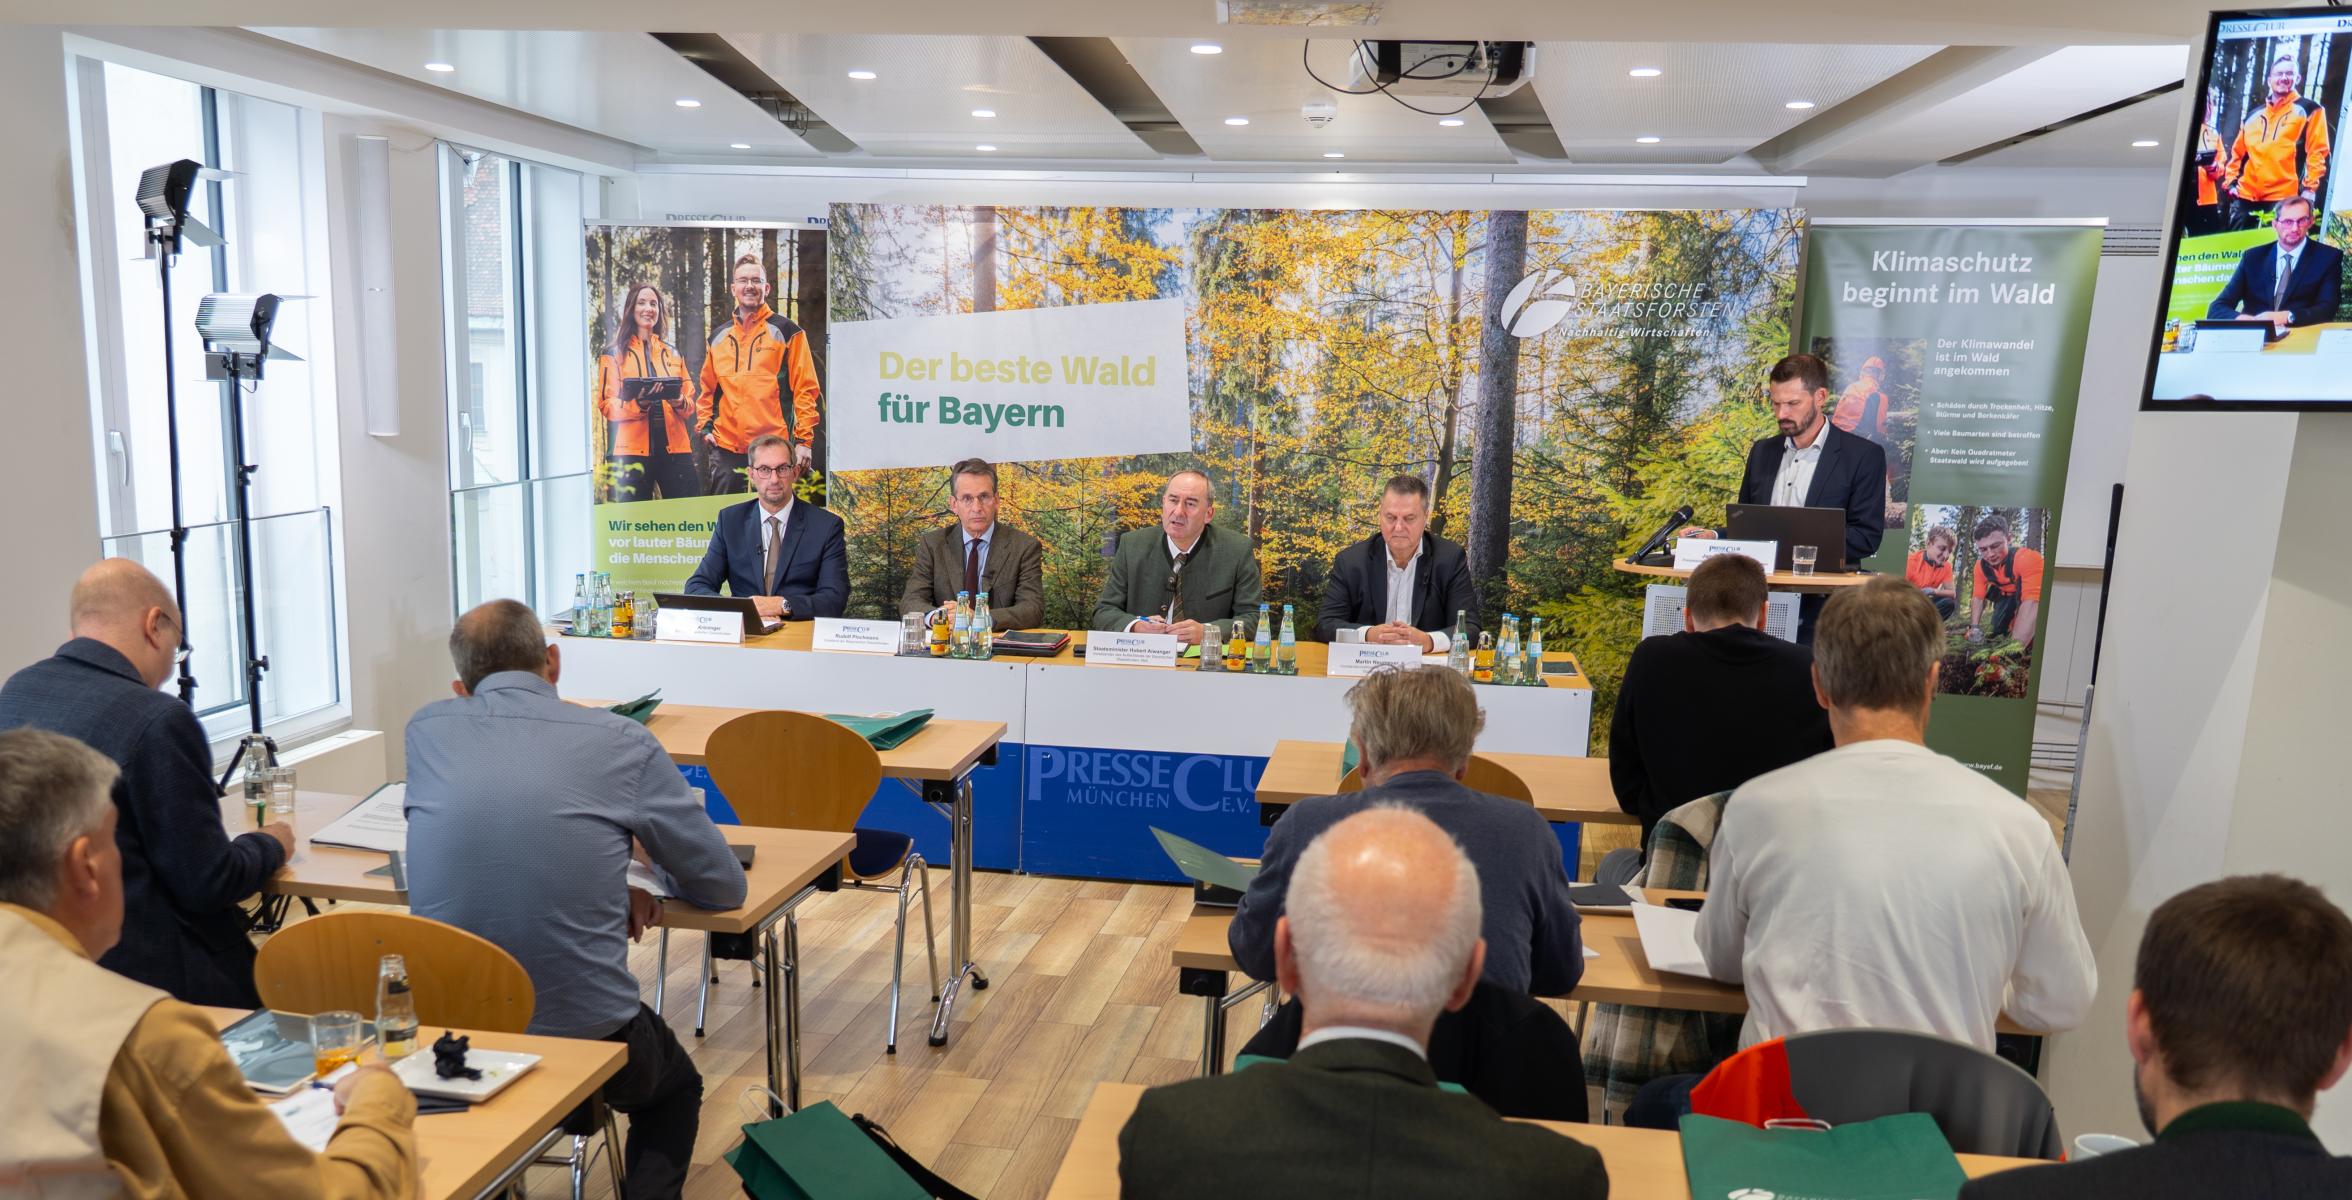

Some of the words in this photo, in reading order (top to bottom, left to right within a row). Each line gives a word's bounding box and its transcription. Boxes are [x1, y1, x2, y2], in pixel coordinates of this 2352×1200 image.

[1872, 250, 2033, 273] Klimaschutz
[1580, 283, 1707, 299] BAYERISCHE
[1842, 282, 1939, 308] beginnt
[1948, 283, 1979, 304] im
[1990, 283, 2055, 305] Wald
[1574, 302, 1737, 318] STAATSFORSTEN
[1559, 328, 1625, 339] Nachhaltig
[1936, 338, 1958, 349] Der
[1961, 338, 2034, 350] Klimawandel
[1935, 352, 1951, 362] ist
[1953, 352, 1968, 362] im
[1971, 352, 2000, 363] Wald
[880, 352, 943, 382] Der
[950, 352, 1053, 384] beste
[1061, 355, 1157, 387] Wald
[1933, 365, 2010, 377] angekommen
[1968, 402, 1988, 410] durch
[878, 392, 930, 424] für
[939, 396, 1065, 434] Bayern
[1933, 429, 1950, 437] Viele
[1952, 430, 1990, 438] Baumarten
[2008, 431, 2041, 439] betroffen
[1951, 448, 1966, 456] Kein
[608, 520, 632, 532] Wir
[634, 520, 676, 532] sehen
[678, 521, 703, 532] den
[608, 537, 632, 548] vor
[633, 536, 672, 548] lauter
[608, 552, 630, 564] die
[1066, 785, 1169, 808] MÜNCHEN
[1221, 796, 1251, 814] E.V.
